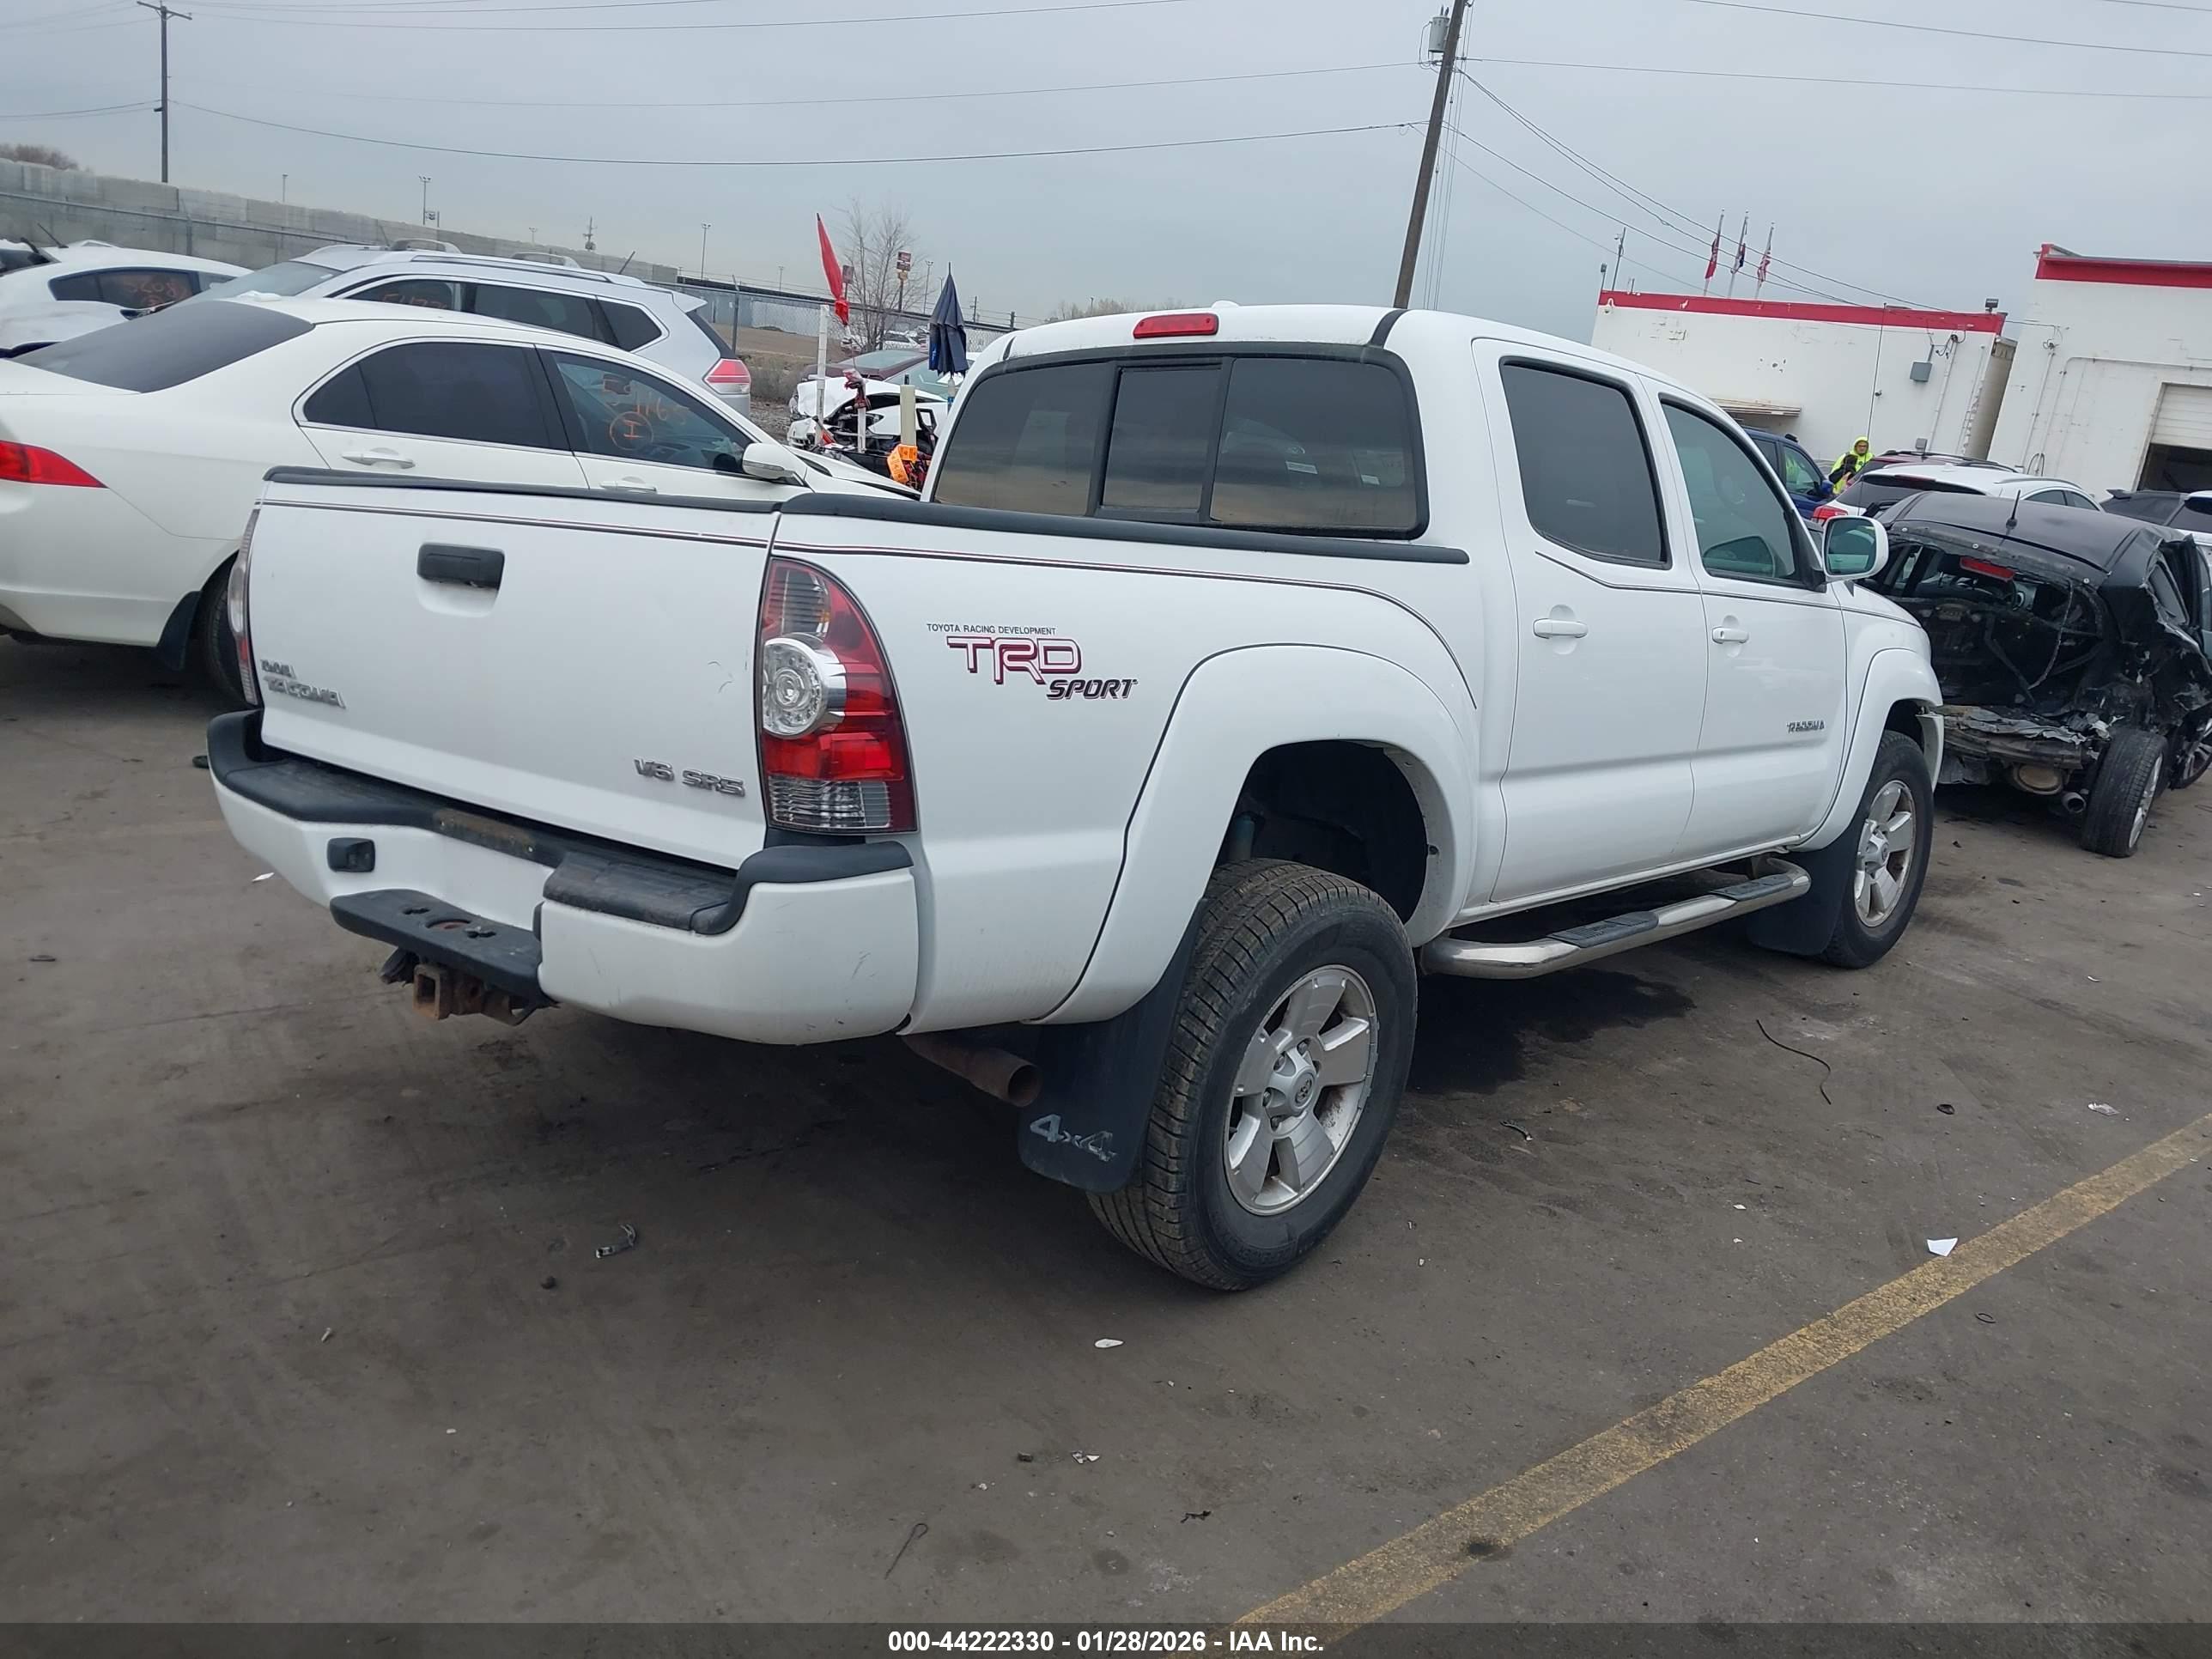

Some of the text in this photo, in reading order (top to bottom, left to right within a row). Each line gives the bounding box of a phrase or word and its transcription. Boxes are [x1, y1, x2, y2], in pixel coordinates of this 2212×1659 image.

[927, 623, 1056, 635] TOYOTA RACING DEVELOPMENT
[946, 635, 1082, 685] TRD
[1047, 678, 1138, 701] SPORT
[634, 757, 745, 798] V6 SR5
